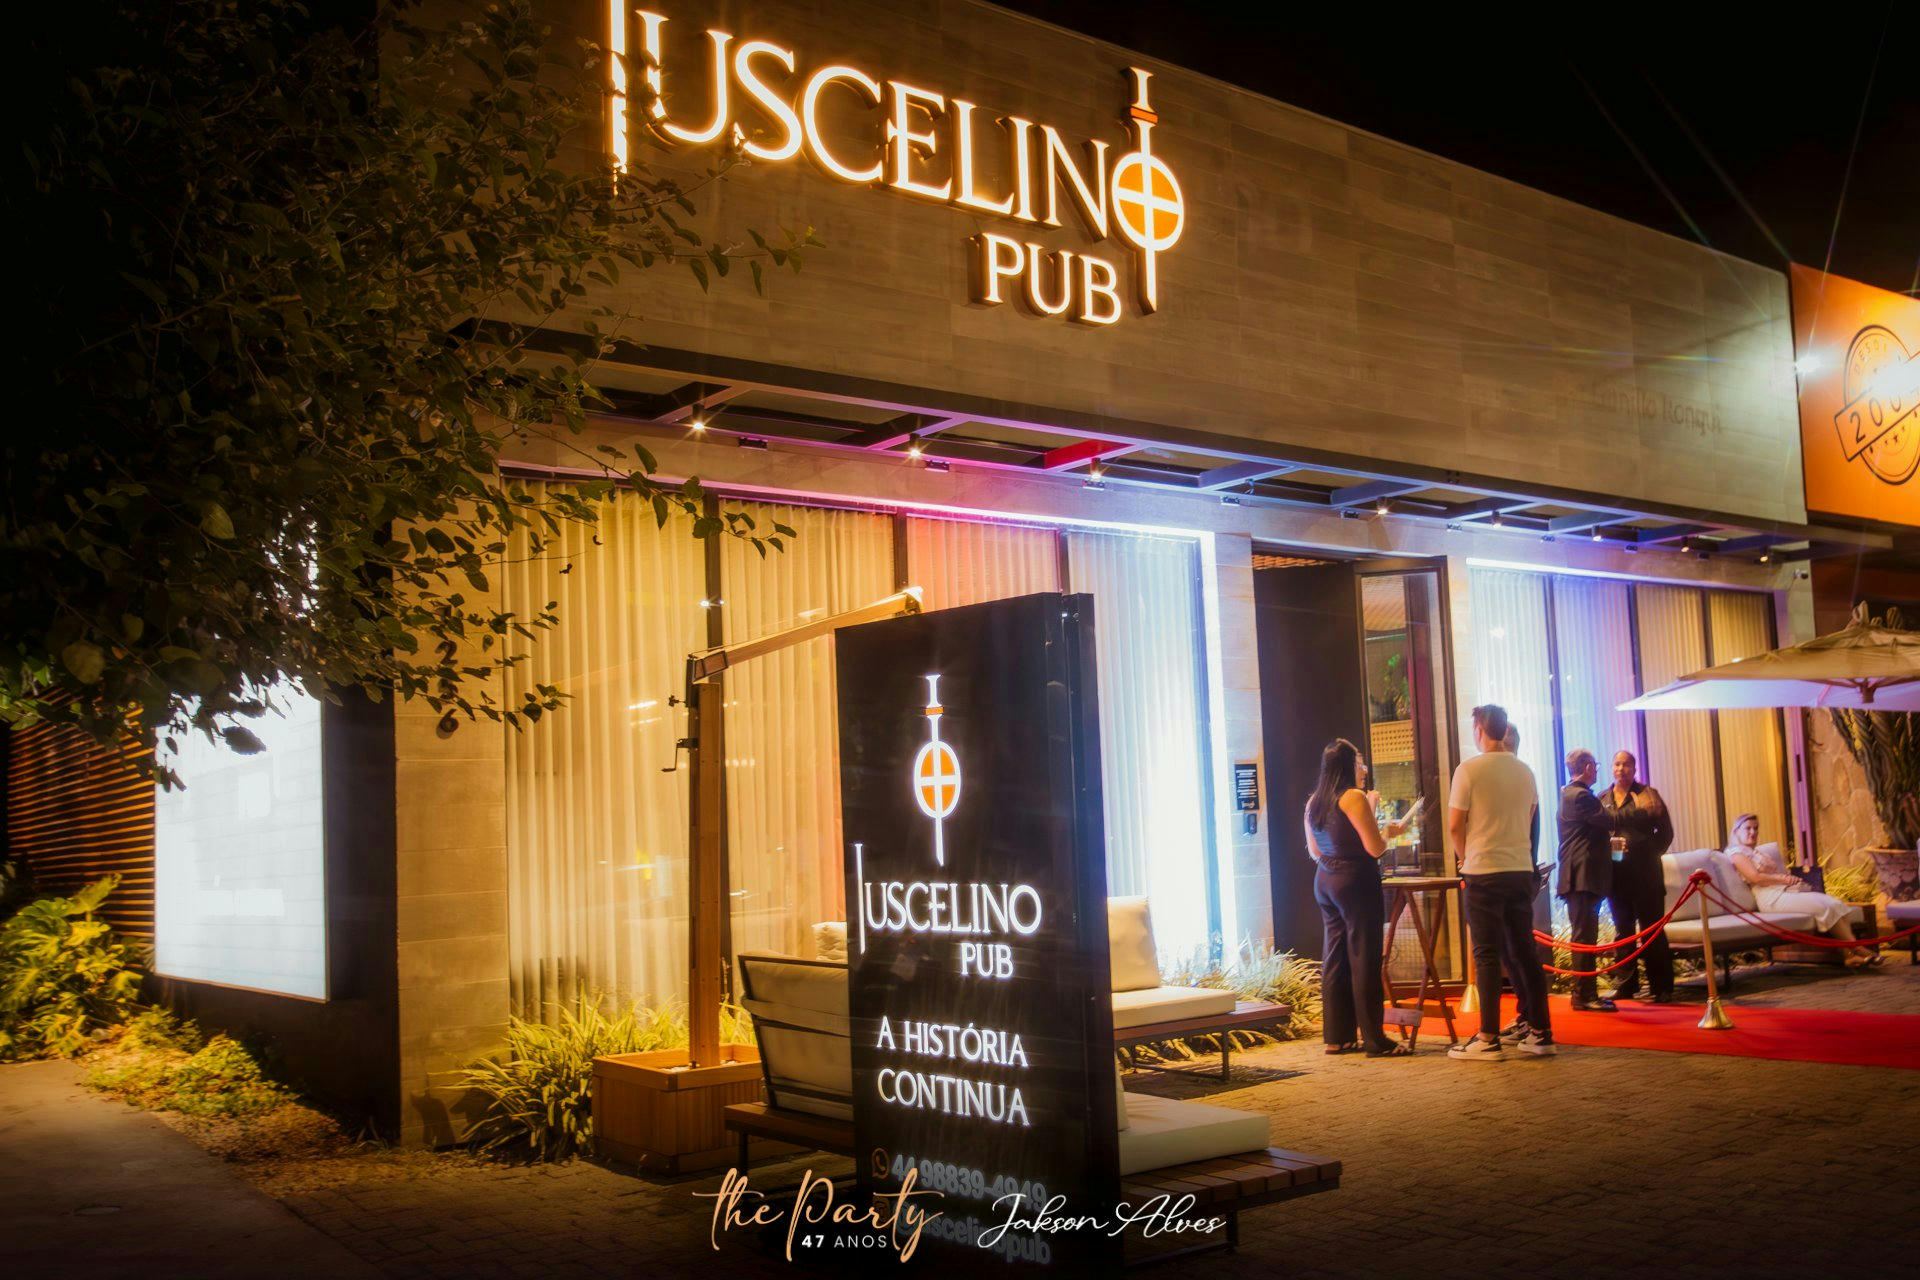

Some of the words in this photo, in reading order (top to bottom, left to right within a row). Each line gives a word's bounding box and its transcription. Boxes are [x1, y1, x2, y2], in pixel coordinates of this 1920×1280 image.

[979, 231, 1122, 325] PUB
[854, 843, 1043, 954] JUSCELINO
[960, 942, 1014, 979] PUB
[876, 1015, 896, 1050] A
[903, 1021, 1029, 1068] HISTÓRIA
[876, 1068, 1031, 1127] CONTINUA
[891, 1154, 917, 1184] 44
